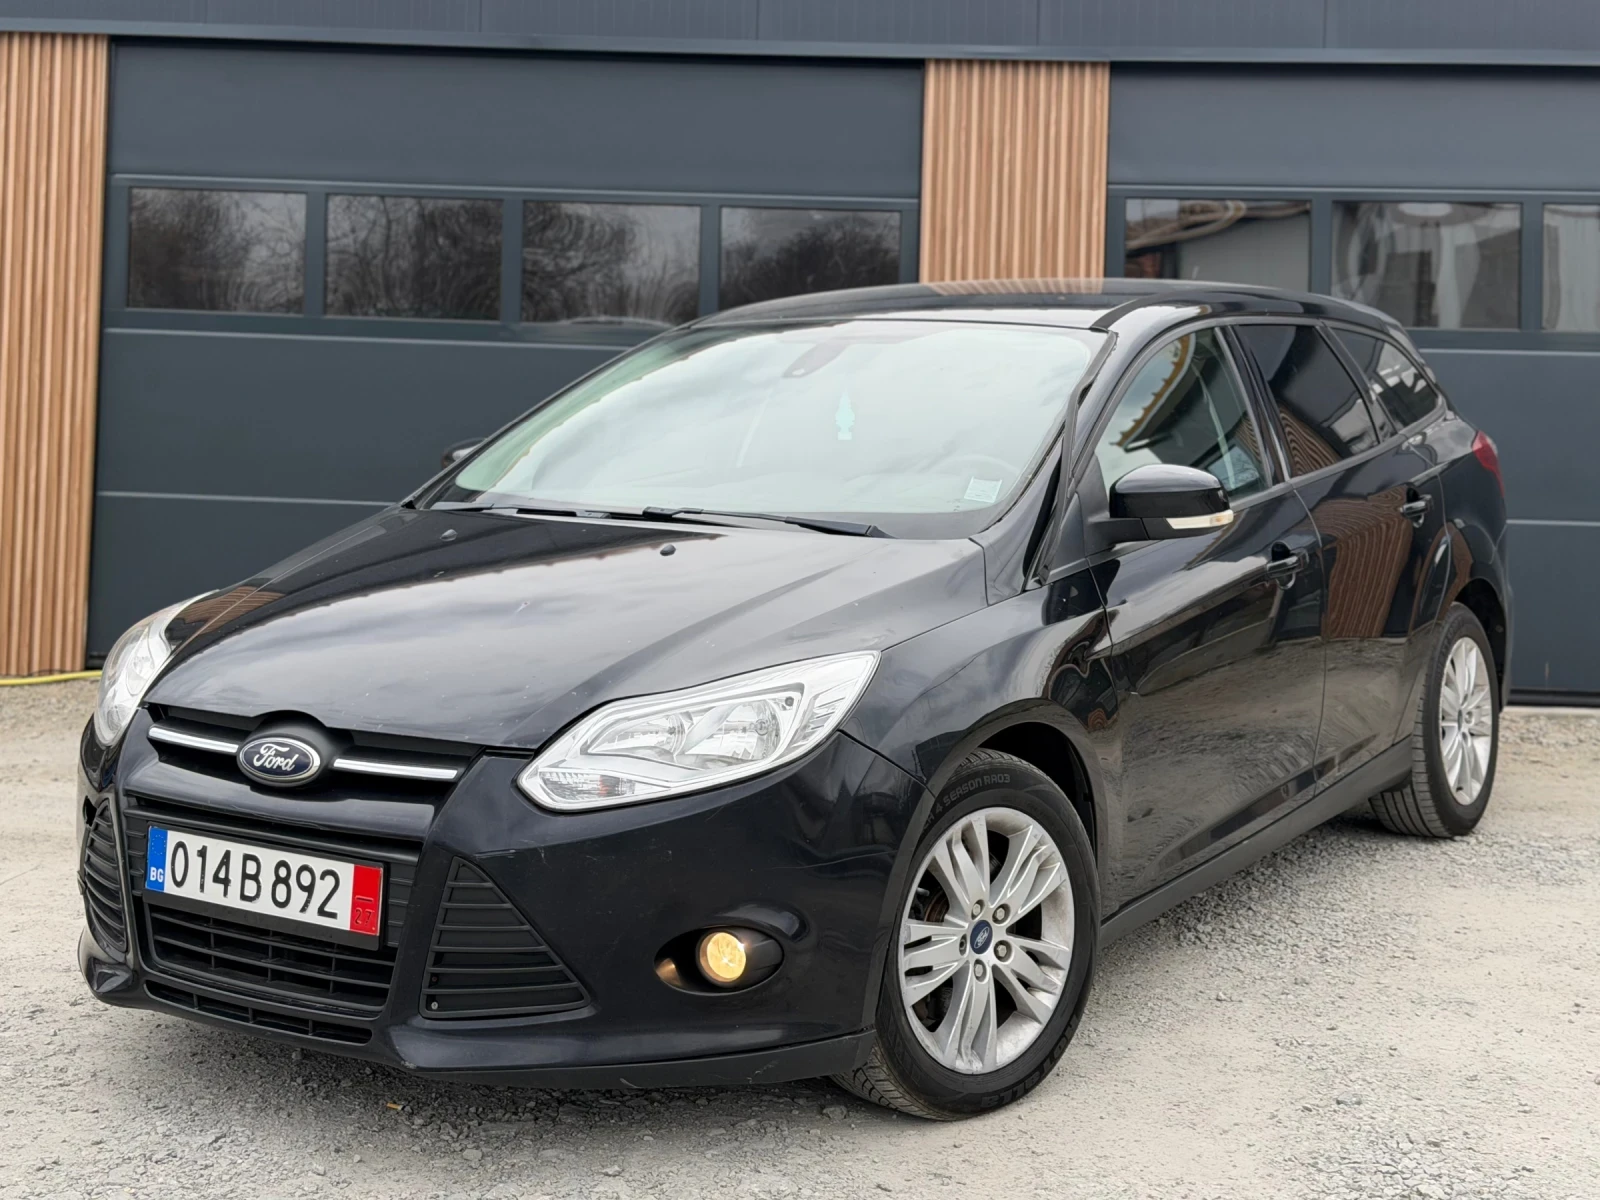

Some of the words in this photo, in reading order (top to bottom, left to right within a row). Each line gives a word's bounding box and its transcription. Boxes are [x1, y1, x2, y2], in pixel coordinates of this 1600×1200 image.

[253, 743, 299, 771] Ford
[936, 803, 943, 814] 4
[943, 777, 982, 806] SEASON
[983, 774, 1011, 785] RA03
[150, 867, 164, 882] BG
